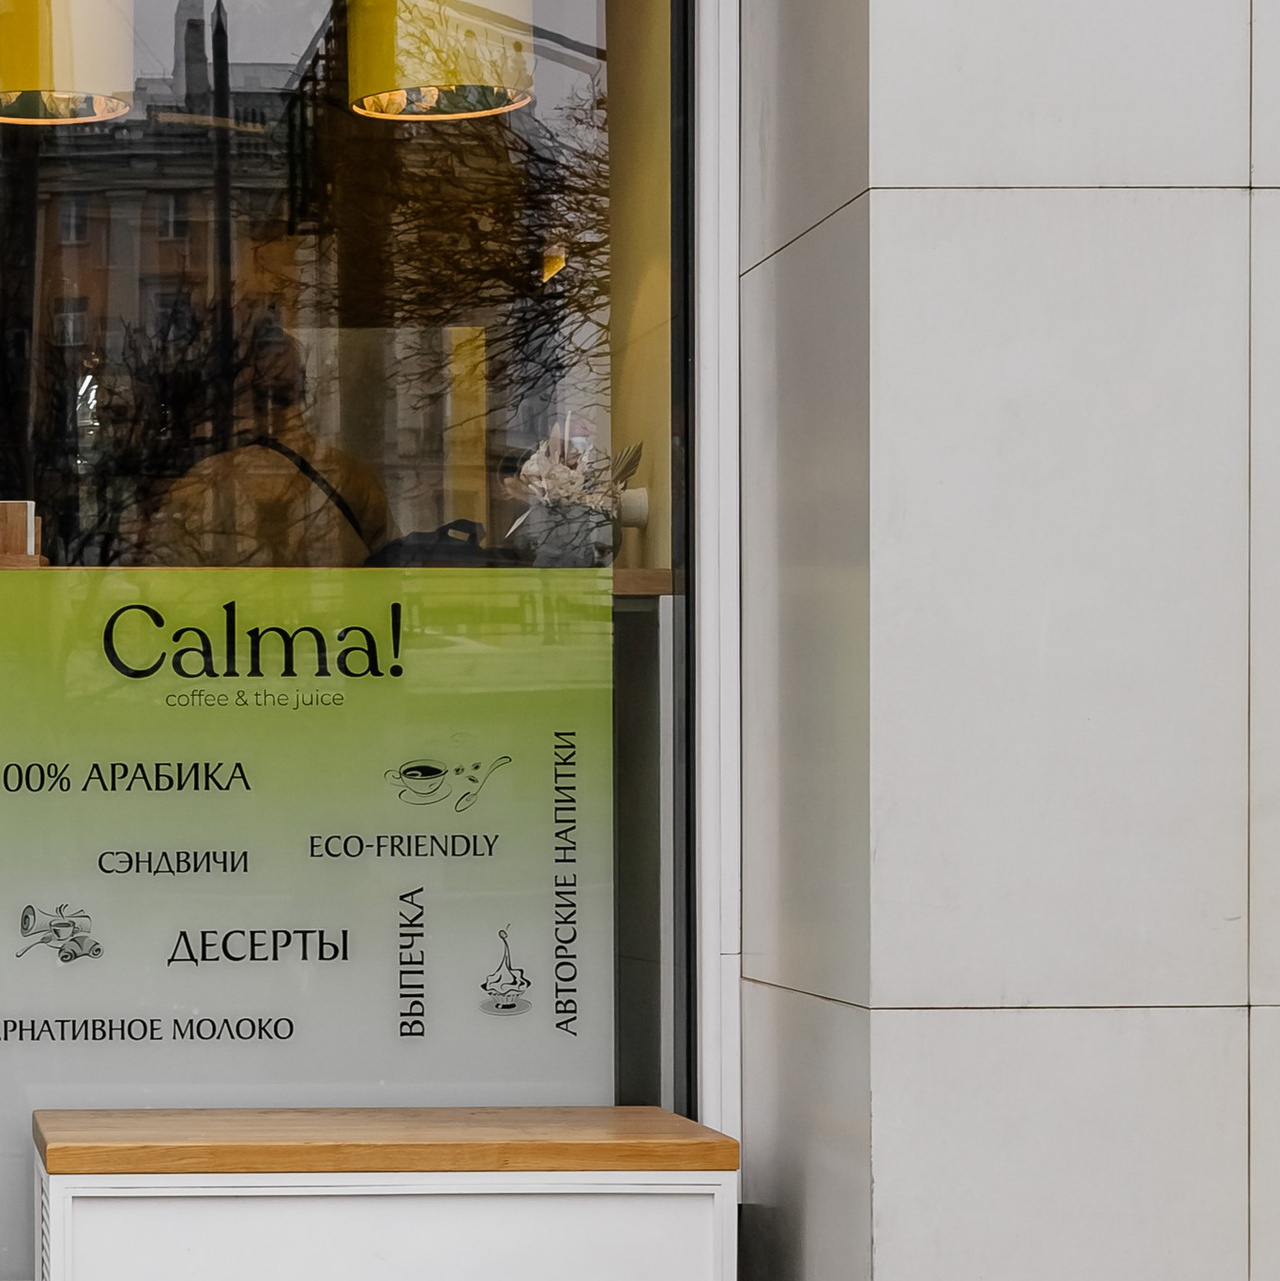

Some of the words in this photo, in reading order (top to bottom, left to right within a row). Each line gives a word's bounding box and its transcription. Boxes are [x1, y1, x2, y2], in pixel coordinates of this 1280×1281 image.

[103, 601, 405, 679] Calma!
[165, 689, 230, 707] coffee
[235, 690, 250, 706] &
[254, 689, 290, 706] the
[292, 689, 345, 710] juice
[81, 762, 252, 792] АРАБИКА
[554, 730, 577, 864] НАПИТКИ
[97, 850, 249, 876] СЭНДВИЧИ
[309, 834, 499, 858] ECO-FRIENDLY
[167, 929, 350, 967] ДЕСЕРТЫ
[399, 886, 425, 1038] ВЫПЕЧКА
[554, 874, 577, 1037] АВТОРСКИЕ
[171, 1017, 294, 1042] МОЛОКО
